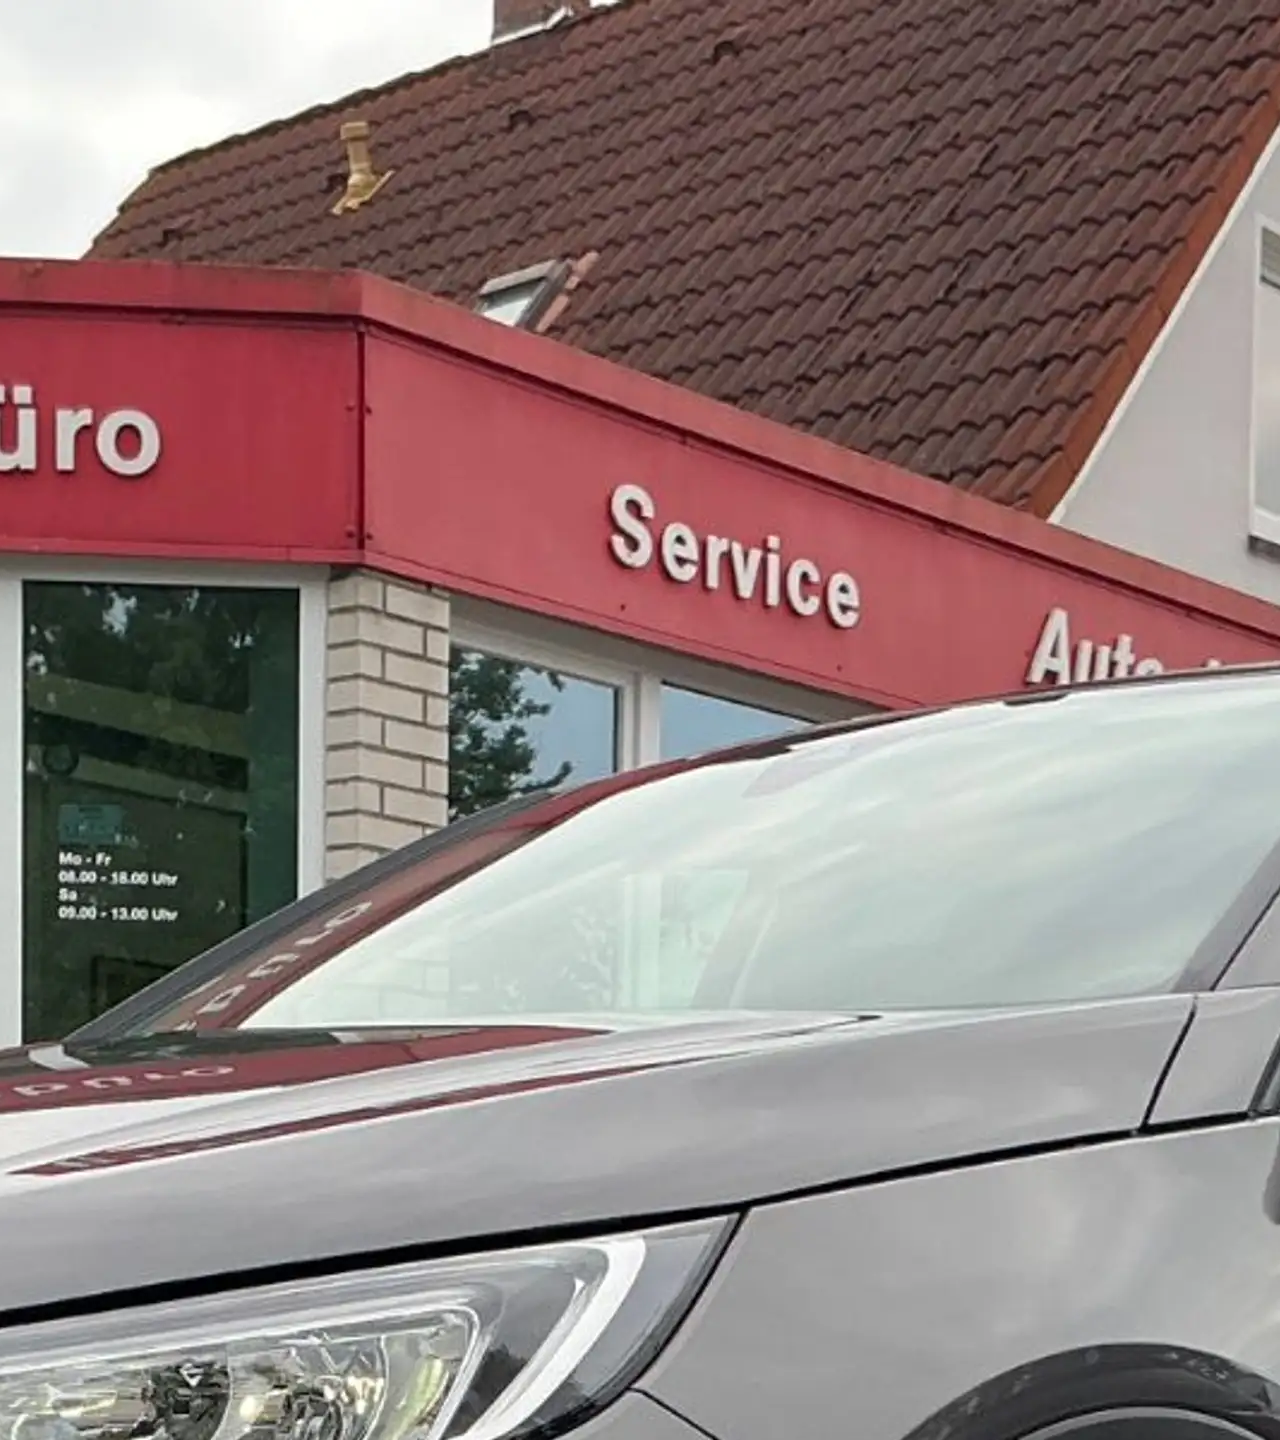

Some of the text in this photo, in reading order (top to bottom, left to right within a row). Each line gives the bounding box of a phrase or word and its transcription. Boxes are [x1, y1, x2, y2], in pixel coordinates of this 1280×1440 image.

[606, 483, 861, 630] Service
[58, 852, 82, 866] Mo
[95, 852, 112, 866] Fr
[152, 872, 178, 886] Uhr
[58, 888, 78, 901] Sa
[152, 908, 178, 922] Uhr
